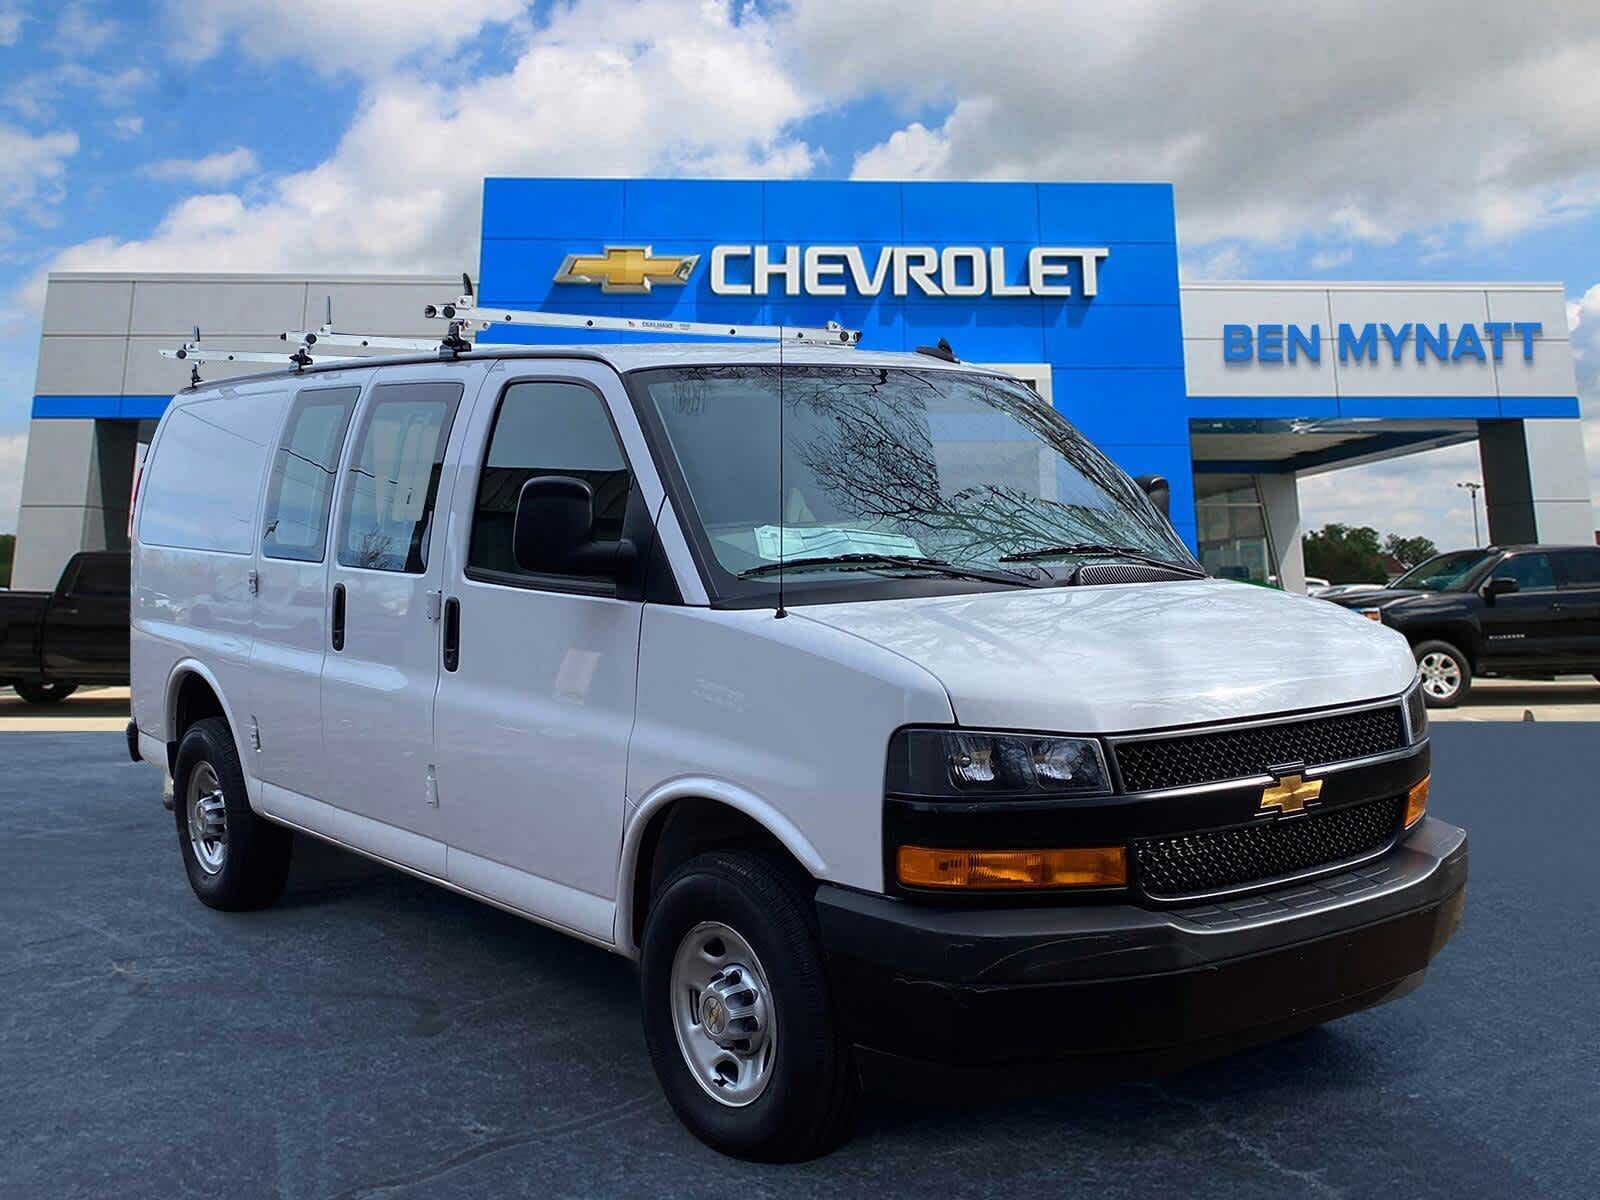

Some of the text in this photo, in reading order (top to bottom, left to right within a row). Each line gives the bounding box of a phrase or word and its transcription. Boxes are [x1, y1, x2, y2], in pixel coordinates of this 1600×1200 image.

[710, 245, 1109, 297] CHEVROLET
[1223, 322, 1542, 362] BEN MYNATT
